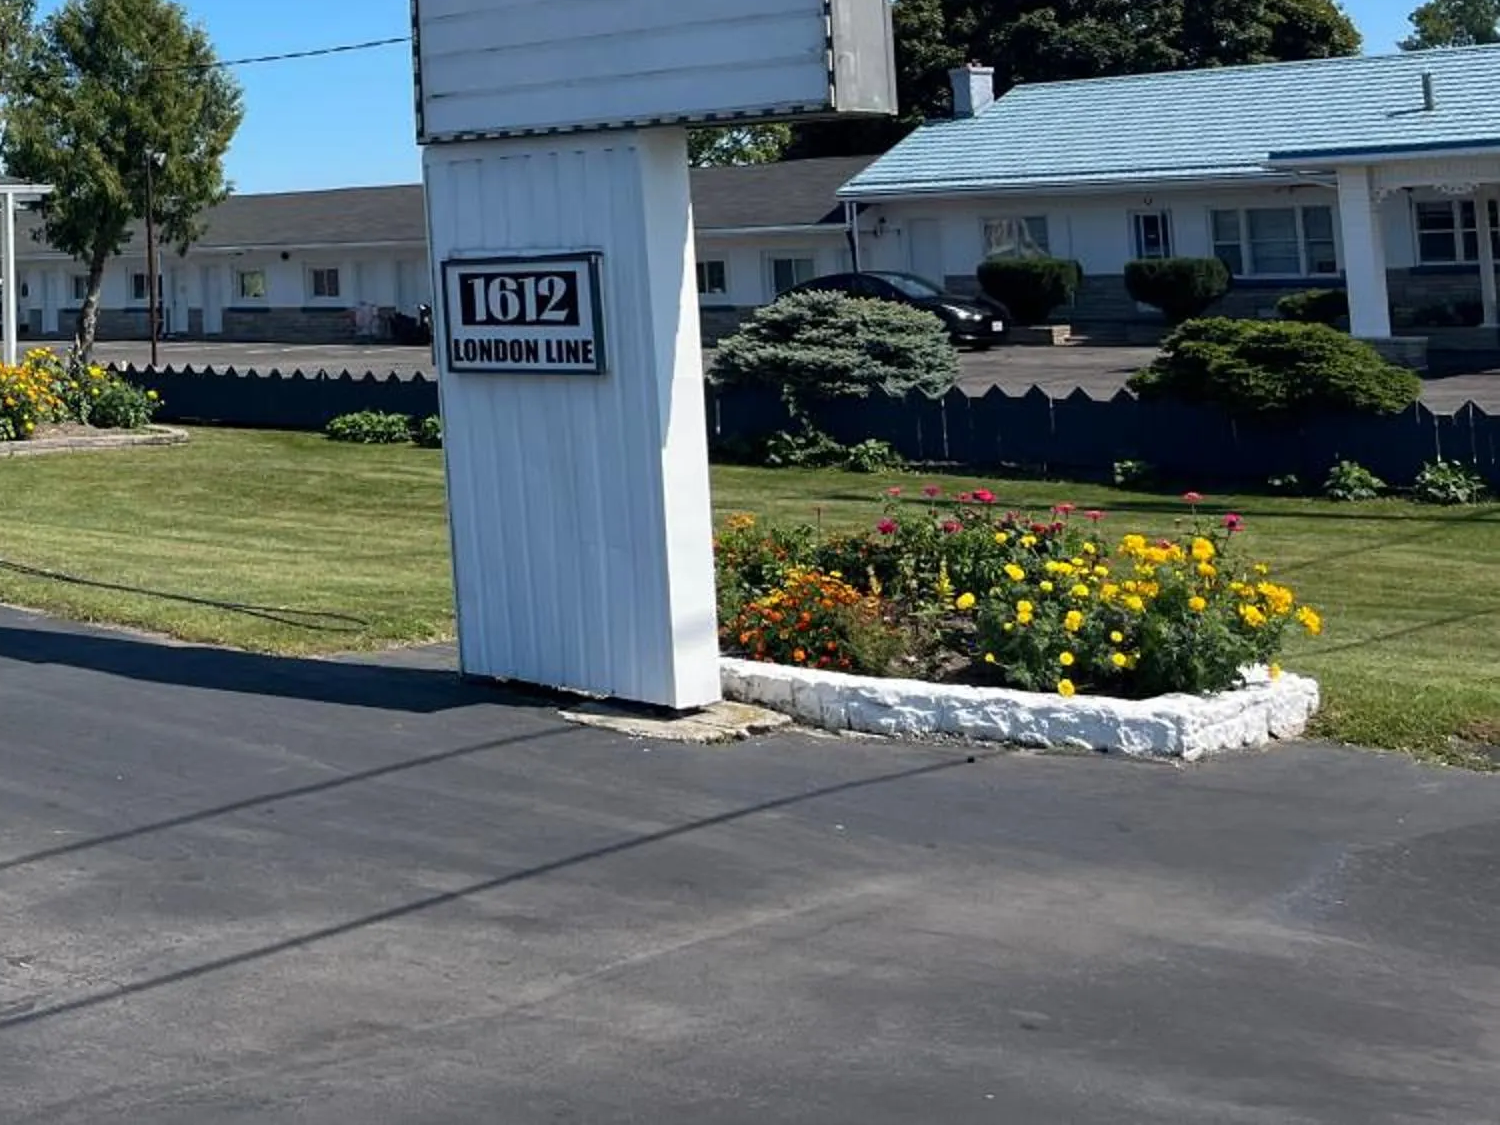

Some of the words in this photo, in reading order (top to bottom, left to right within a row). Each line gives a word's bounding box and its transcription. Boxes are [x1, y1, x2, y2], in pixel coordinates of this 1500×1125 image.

[467, 275, 569, 322] 1612
[453, 338, 540, 364] LONDON
[545, 339, 595, 364] LINE
